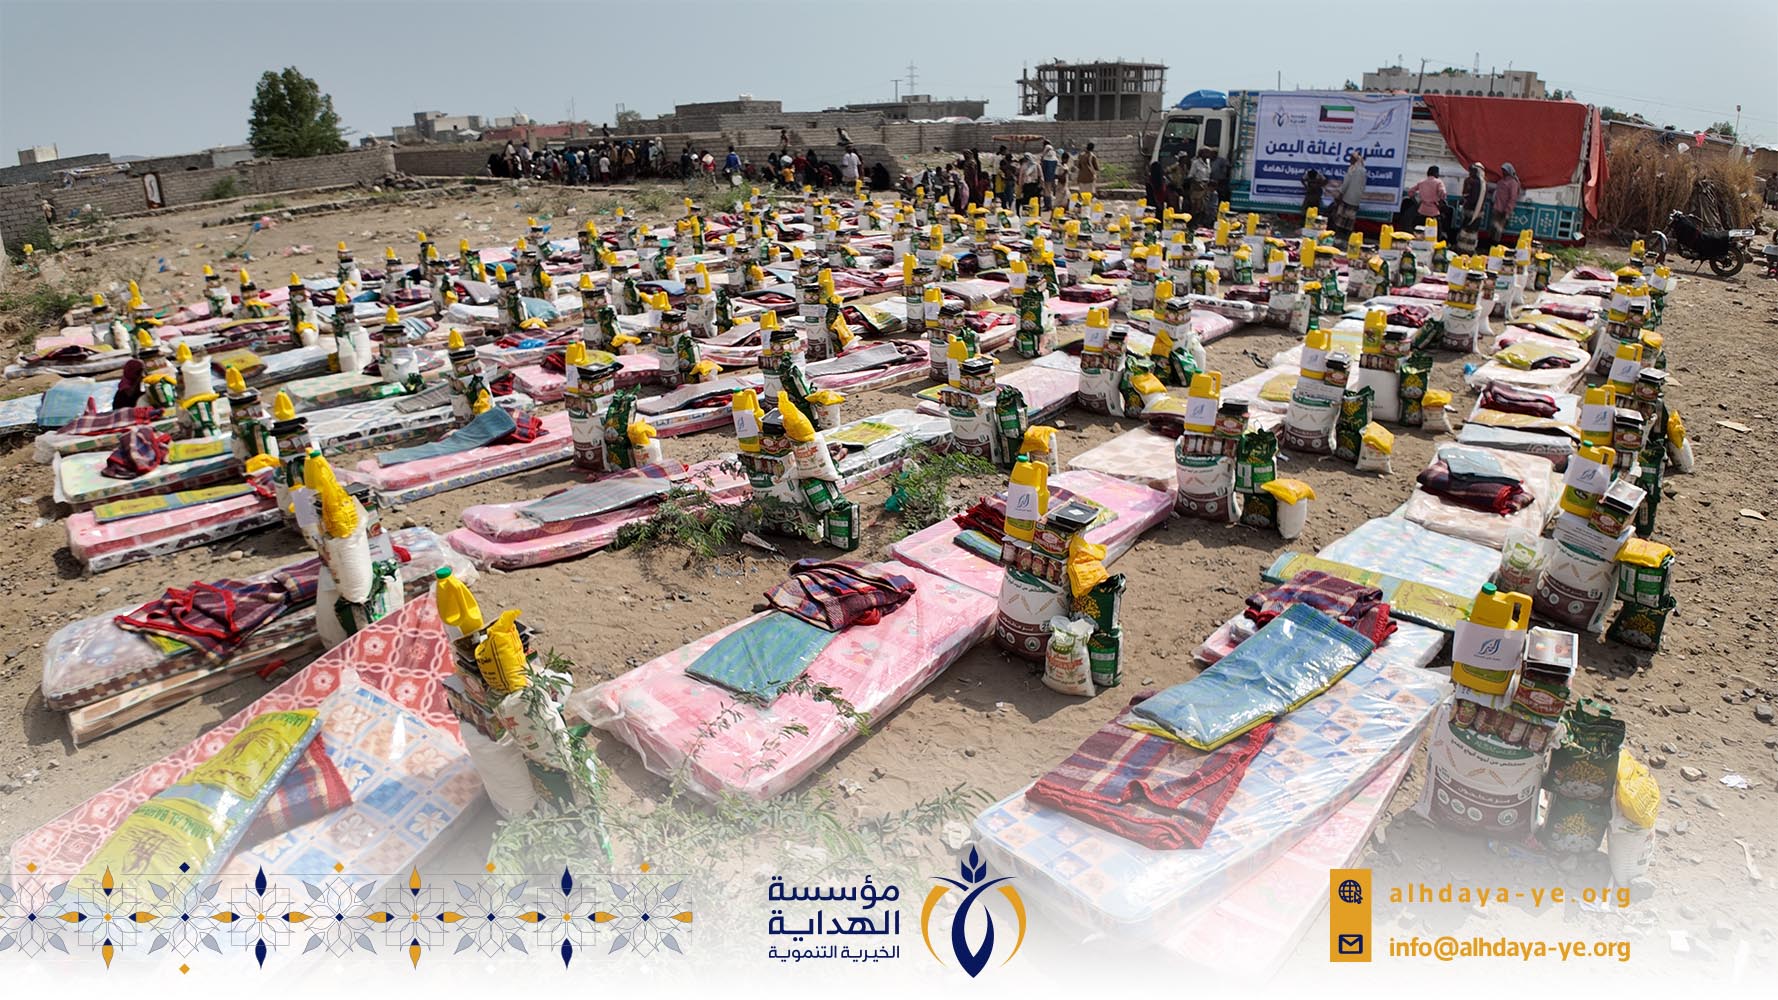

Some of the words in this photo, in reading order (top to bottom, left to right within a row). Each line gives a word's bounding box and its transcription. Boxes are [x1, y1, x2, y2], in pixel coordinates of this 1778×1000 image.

[1265, 139, 1304, 157] اليمن
[1307, 139, 1342, 162] إغاثة
[1343, 141, 1395, 164] مشروع
